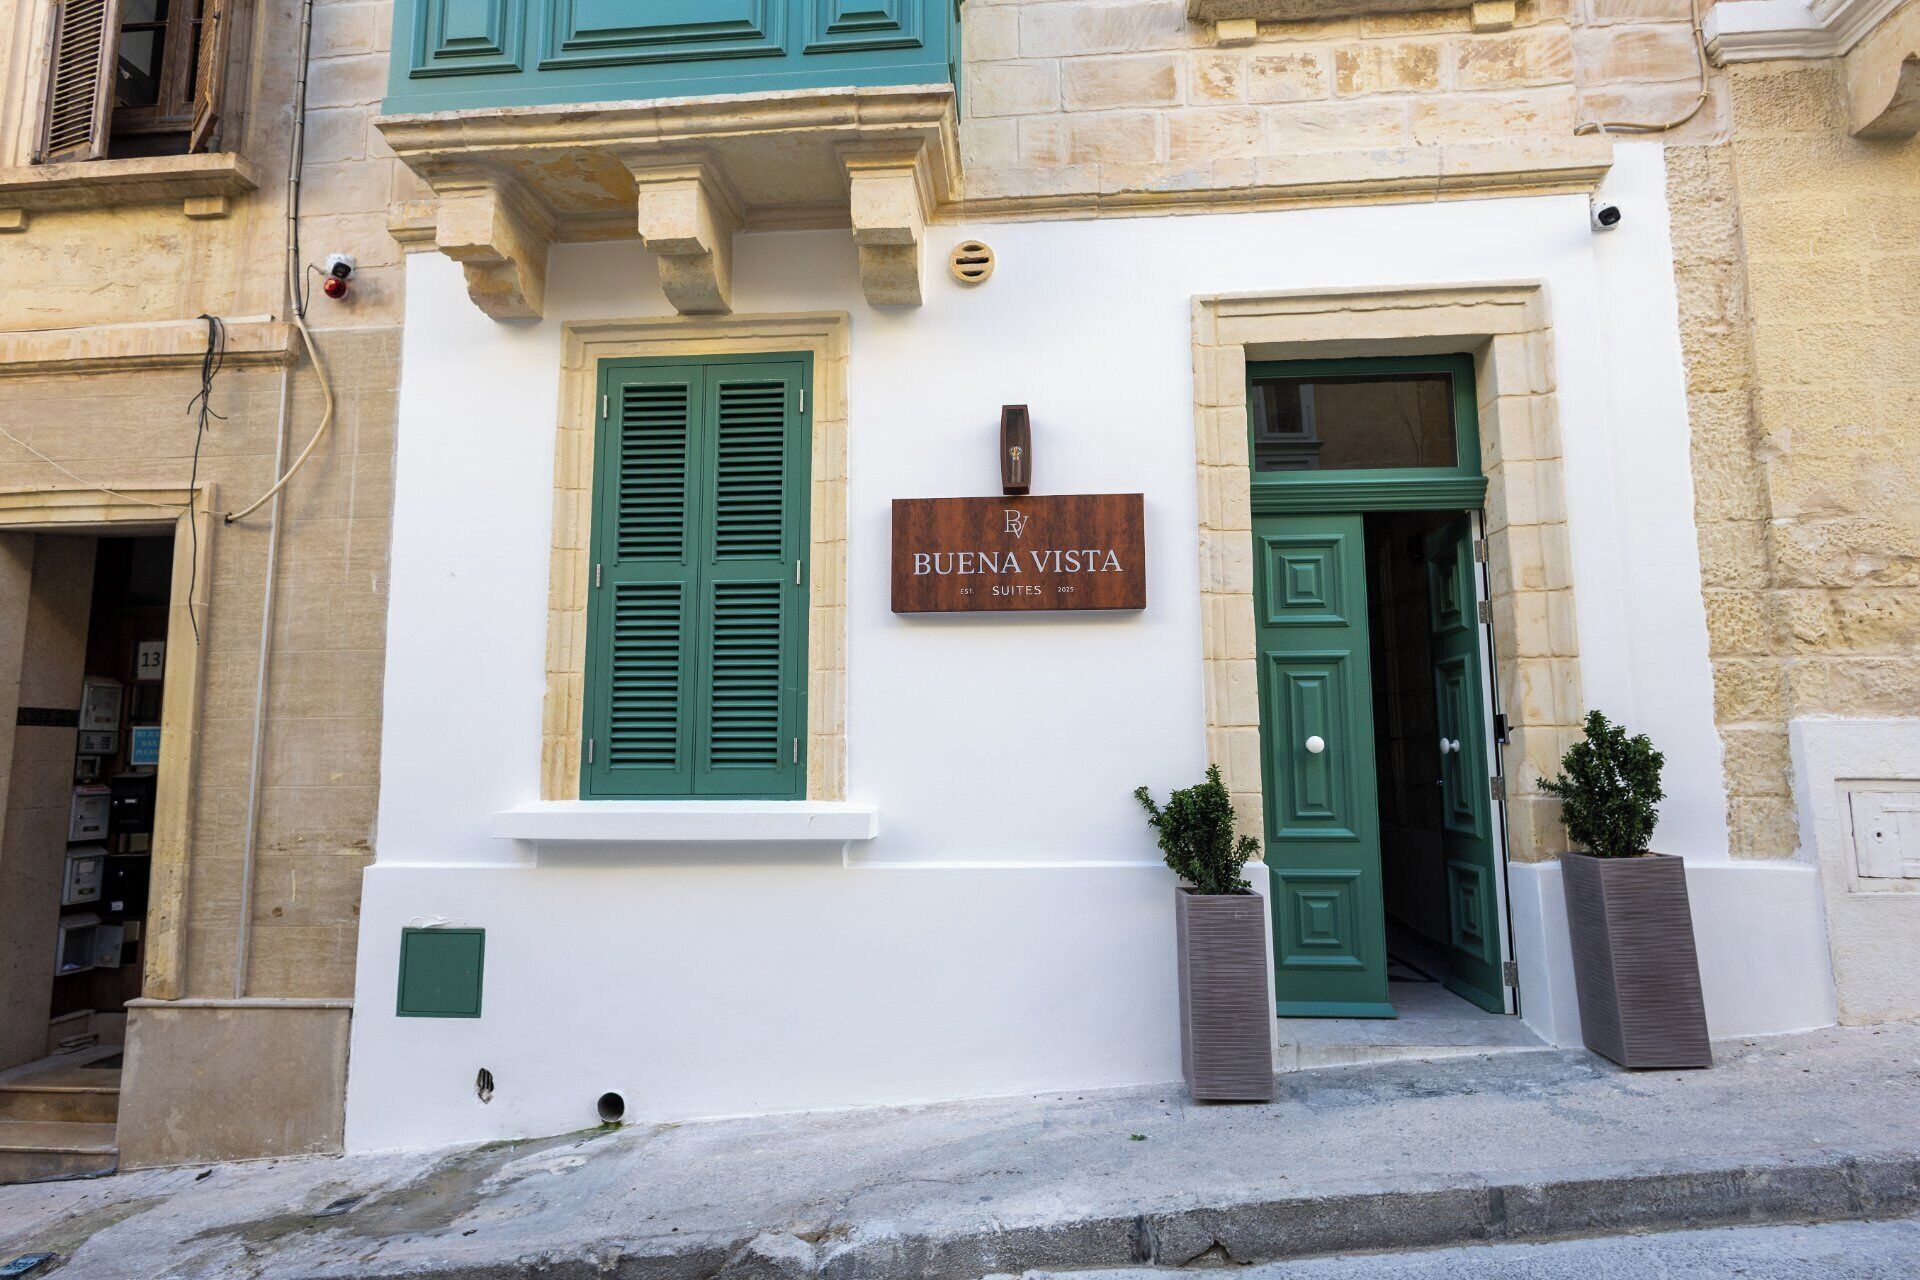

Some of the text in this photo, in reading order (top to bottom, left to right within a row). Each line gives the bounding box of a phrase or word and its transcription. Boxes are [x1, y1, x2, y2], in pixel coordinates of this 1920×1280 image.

[1003, 509, 1030, 539] BV
[912, 549, 1123, 575] BUENA VISTA
[992, 585, 1042, 596] SUITES
[141, 652, 161, 667] 13
